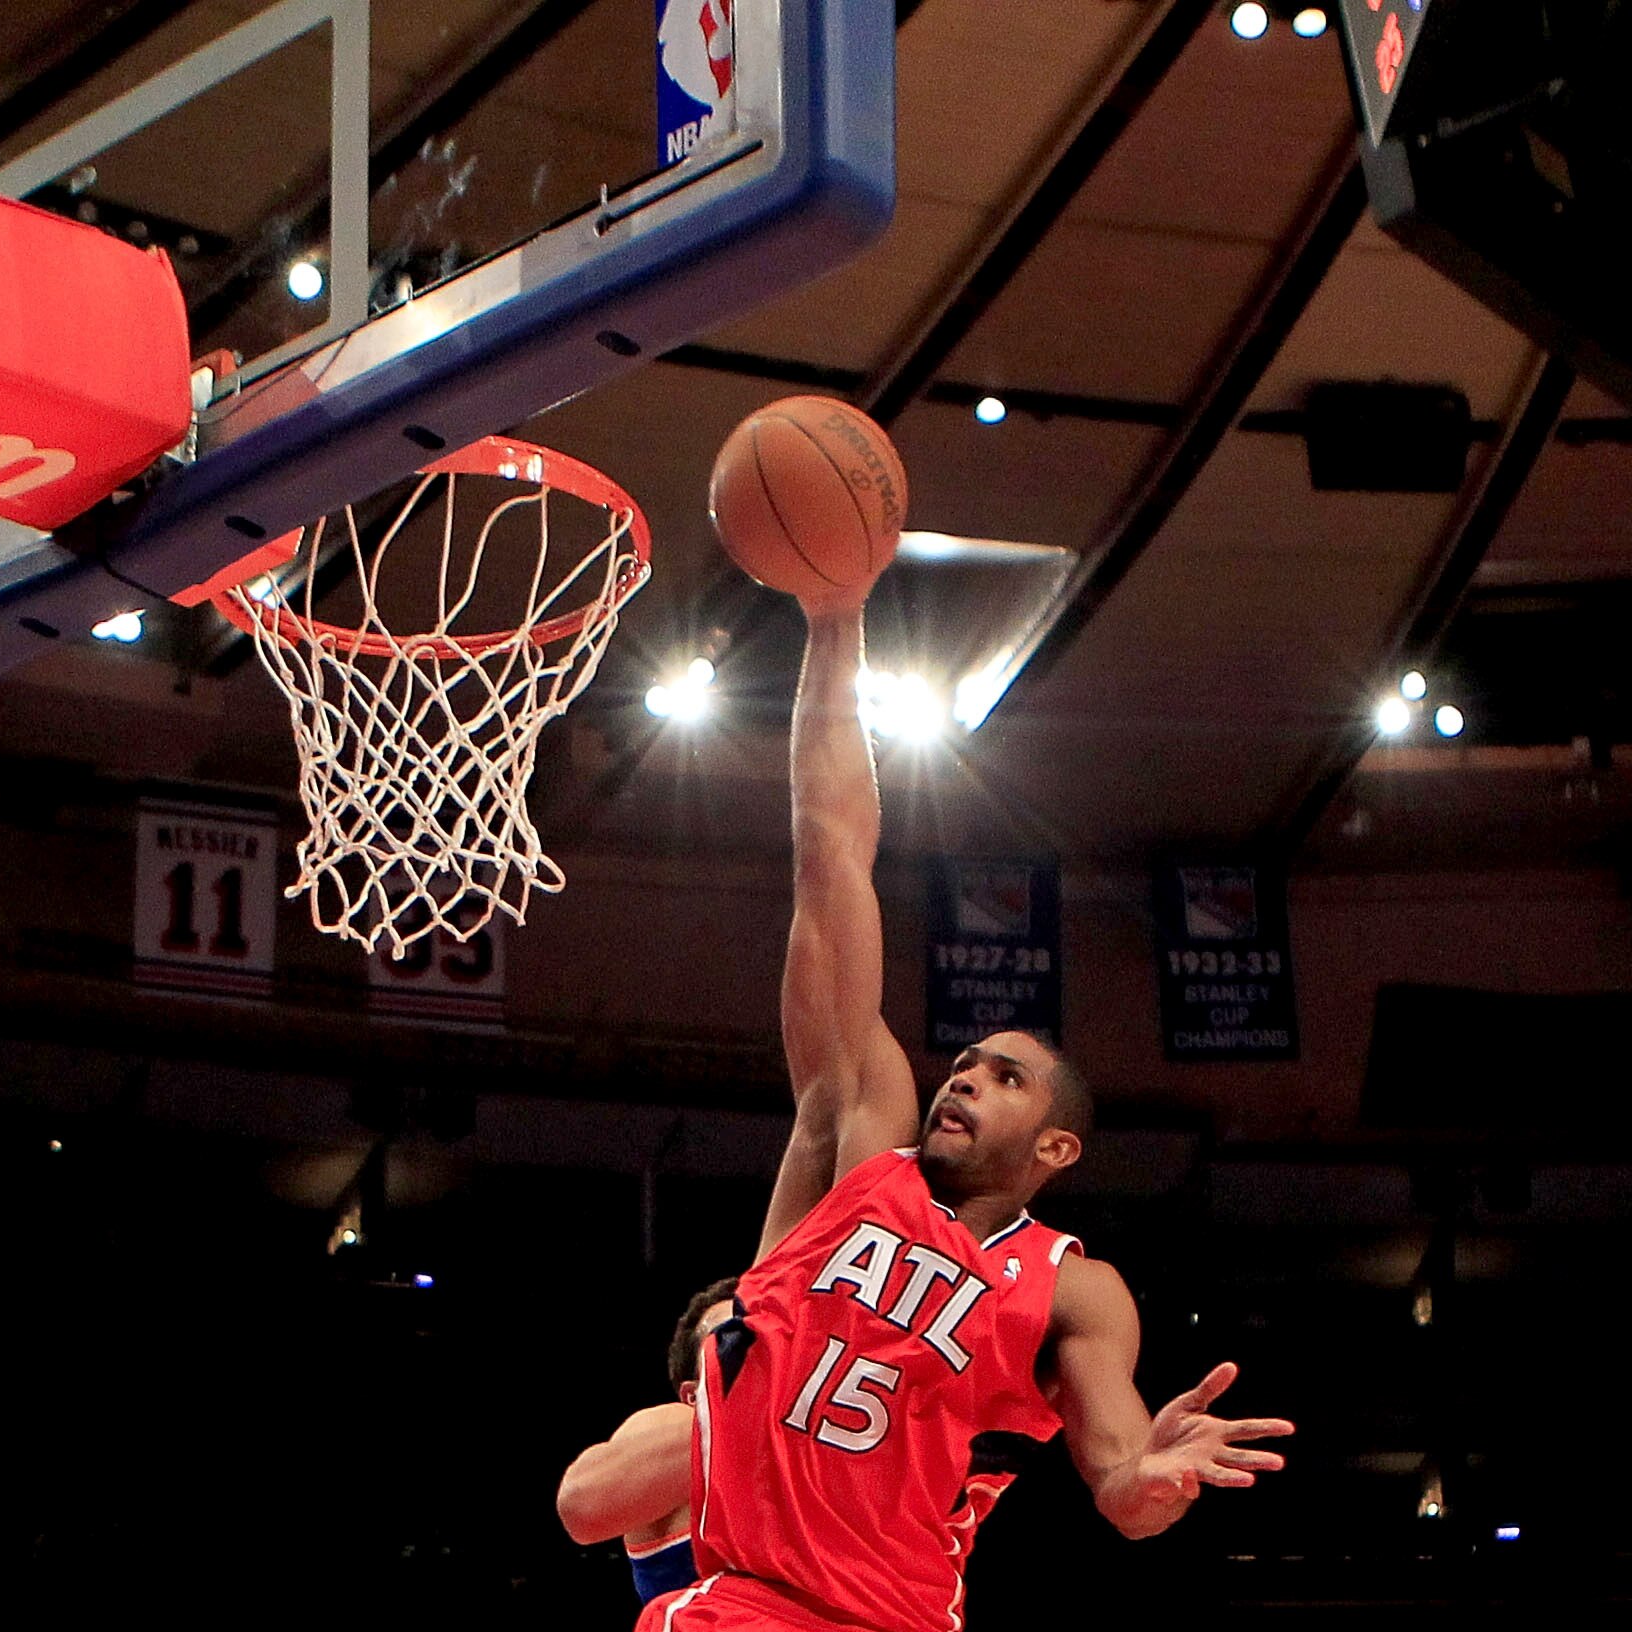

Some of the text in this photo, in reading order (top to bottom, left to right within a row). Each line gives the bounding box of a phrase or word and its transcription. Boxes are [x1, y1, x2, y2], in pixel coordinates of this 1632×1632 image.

[161, 860, 249, 957] 11
[949, 980, 1040, 1001] STANLEY
[1183, 982, 1270, 1004] STANLEY
[971, 1001, 1018, 1023] CUP
[1209, 1006, 1251, 1026] CUP
[1173, 1027, 1291, 1050] CHAMPIONS
[810, 1222, 990, 1373] ATL
[782, 1336, 901, 1452] 15
